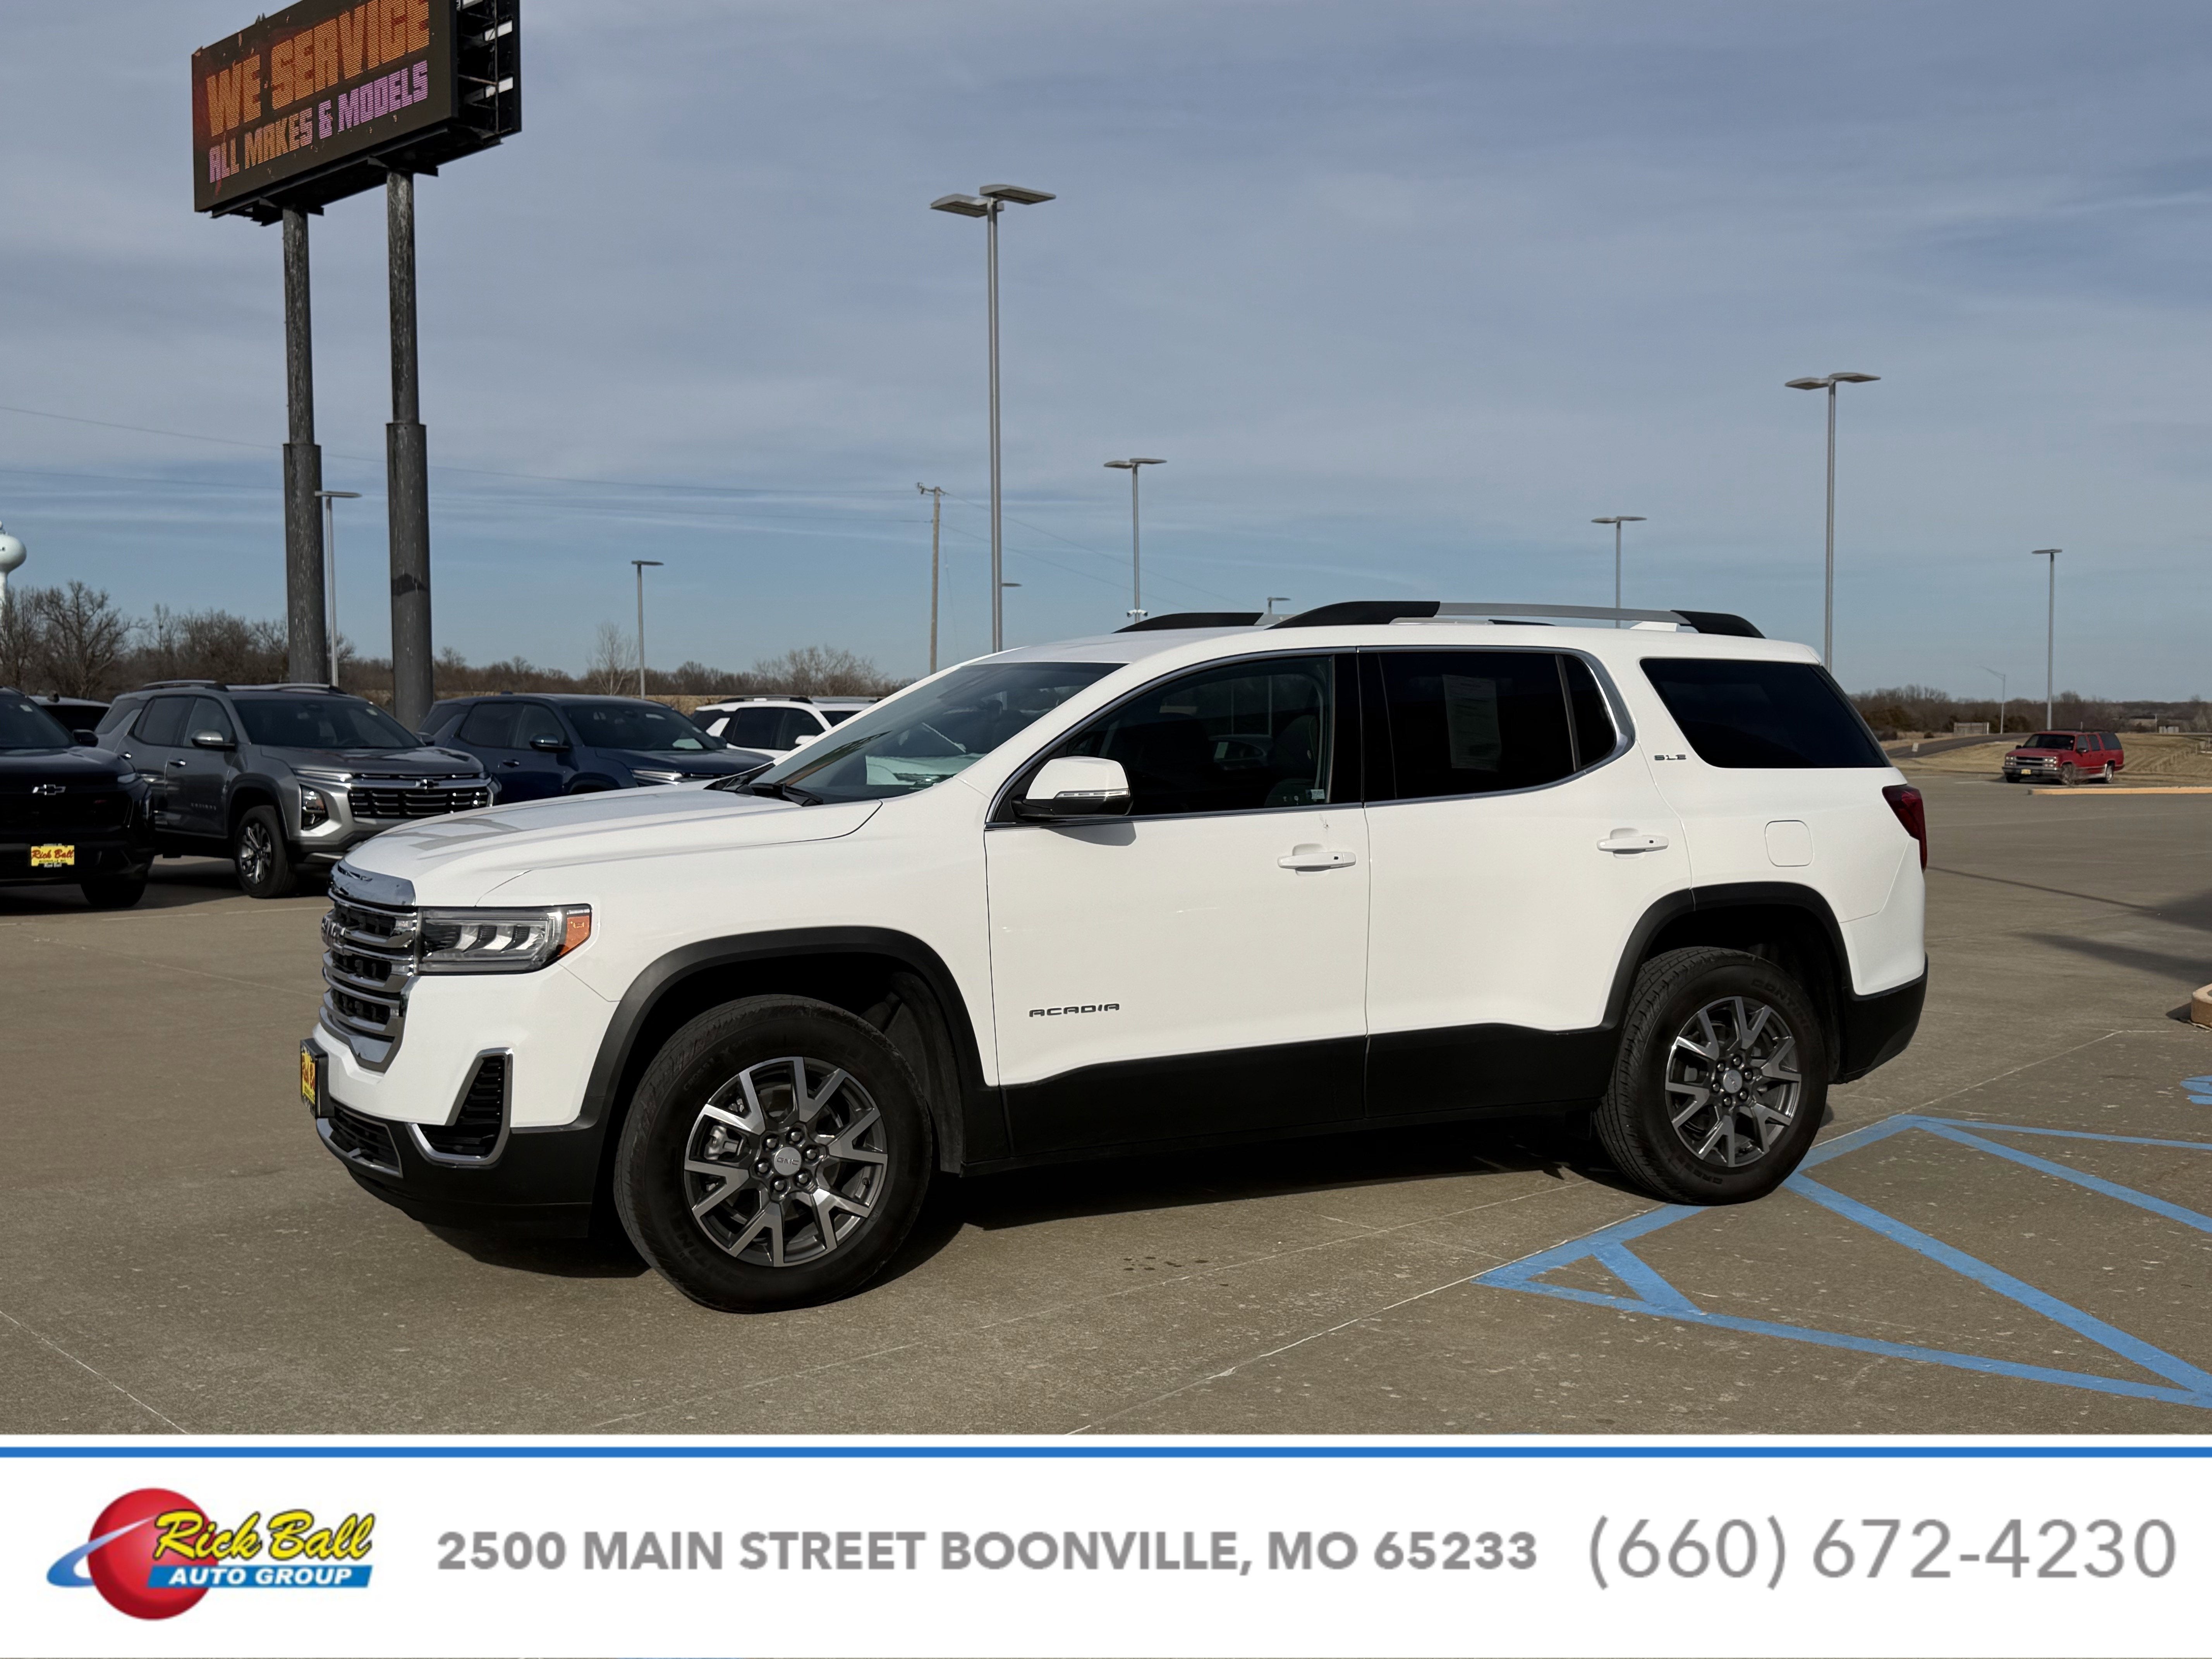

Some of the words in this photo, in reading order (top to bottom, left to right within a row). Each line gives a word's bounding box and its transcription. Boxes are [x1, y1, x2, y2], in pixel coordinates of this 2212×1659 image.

[206, 54, 261, 137] WE
[271, 0, 429, 110] SERVICE
[209, 138, 239, 183] ALL
[245, 108, 313, 169] MAKES
[318, 100, 332, 139] &
[338, 60, 428, 132] MODELS
[32, 850, 52, 859] Rick
[54, 849, 74, 858] Ball
[1029, 1003, 1120, 1017] ACADIA
[777, 1157, 799, 1165] GMC
